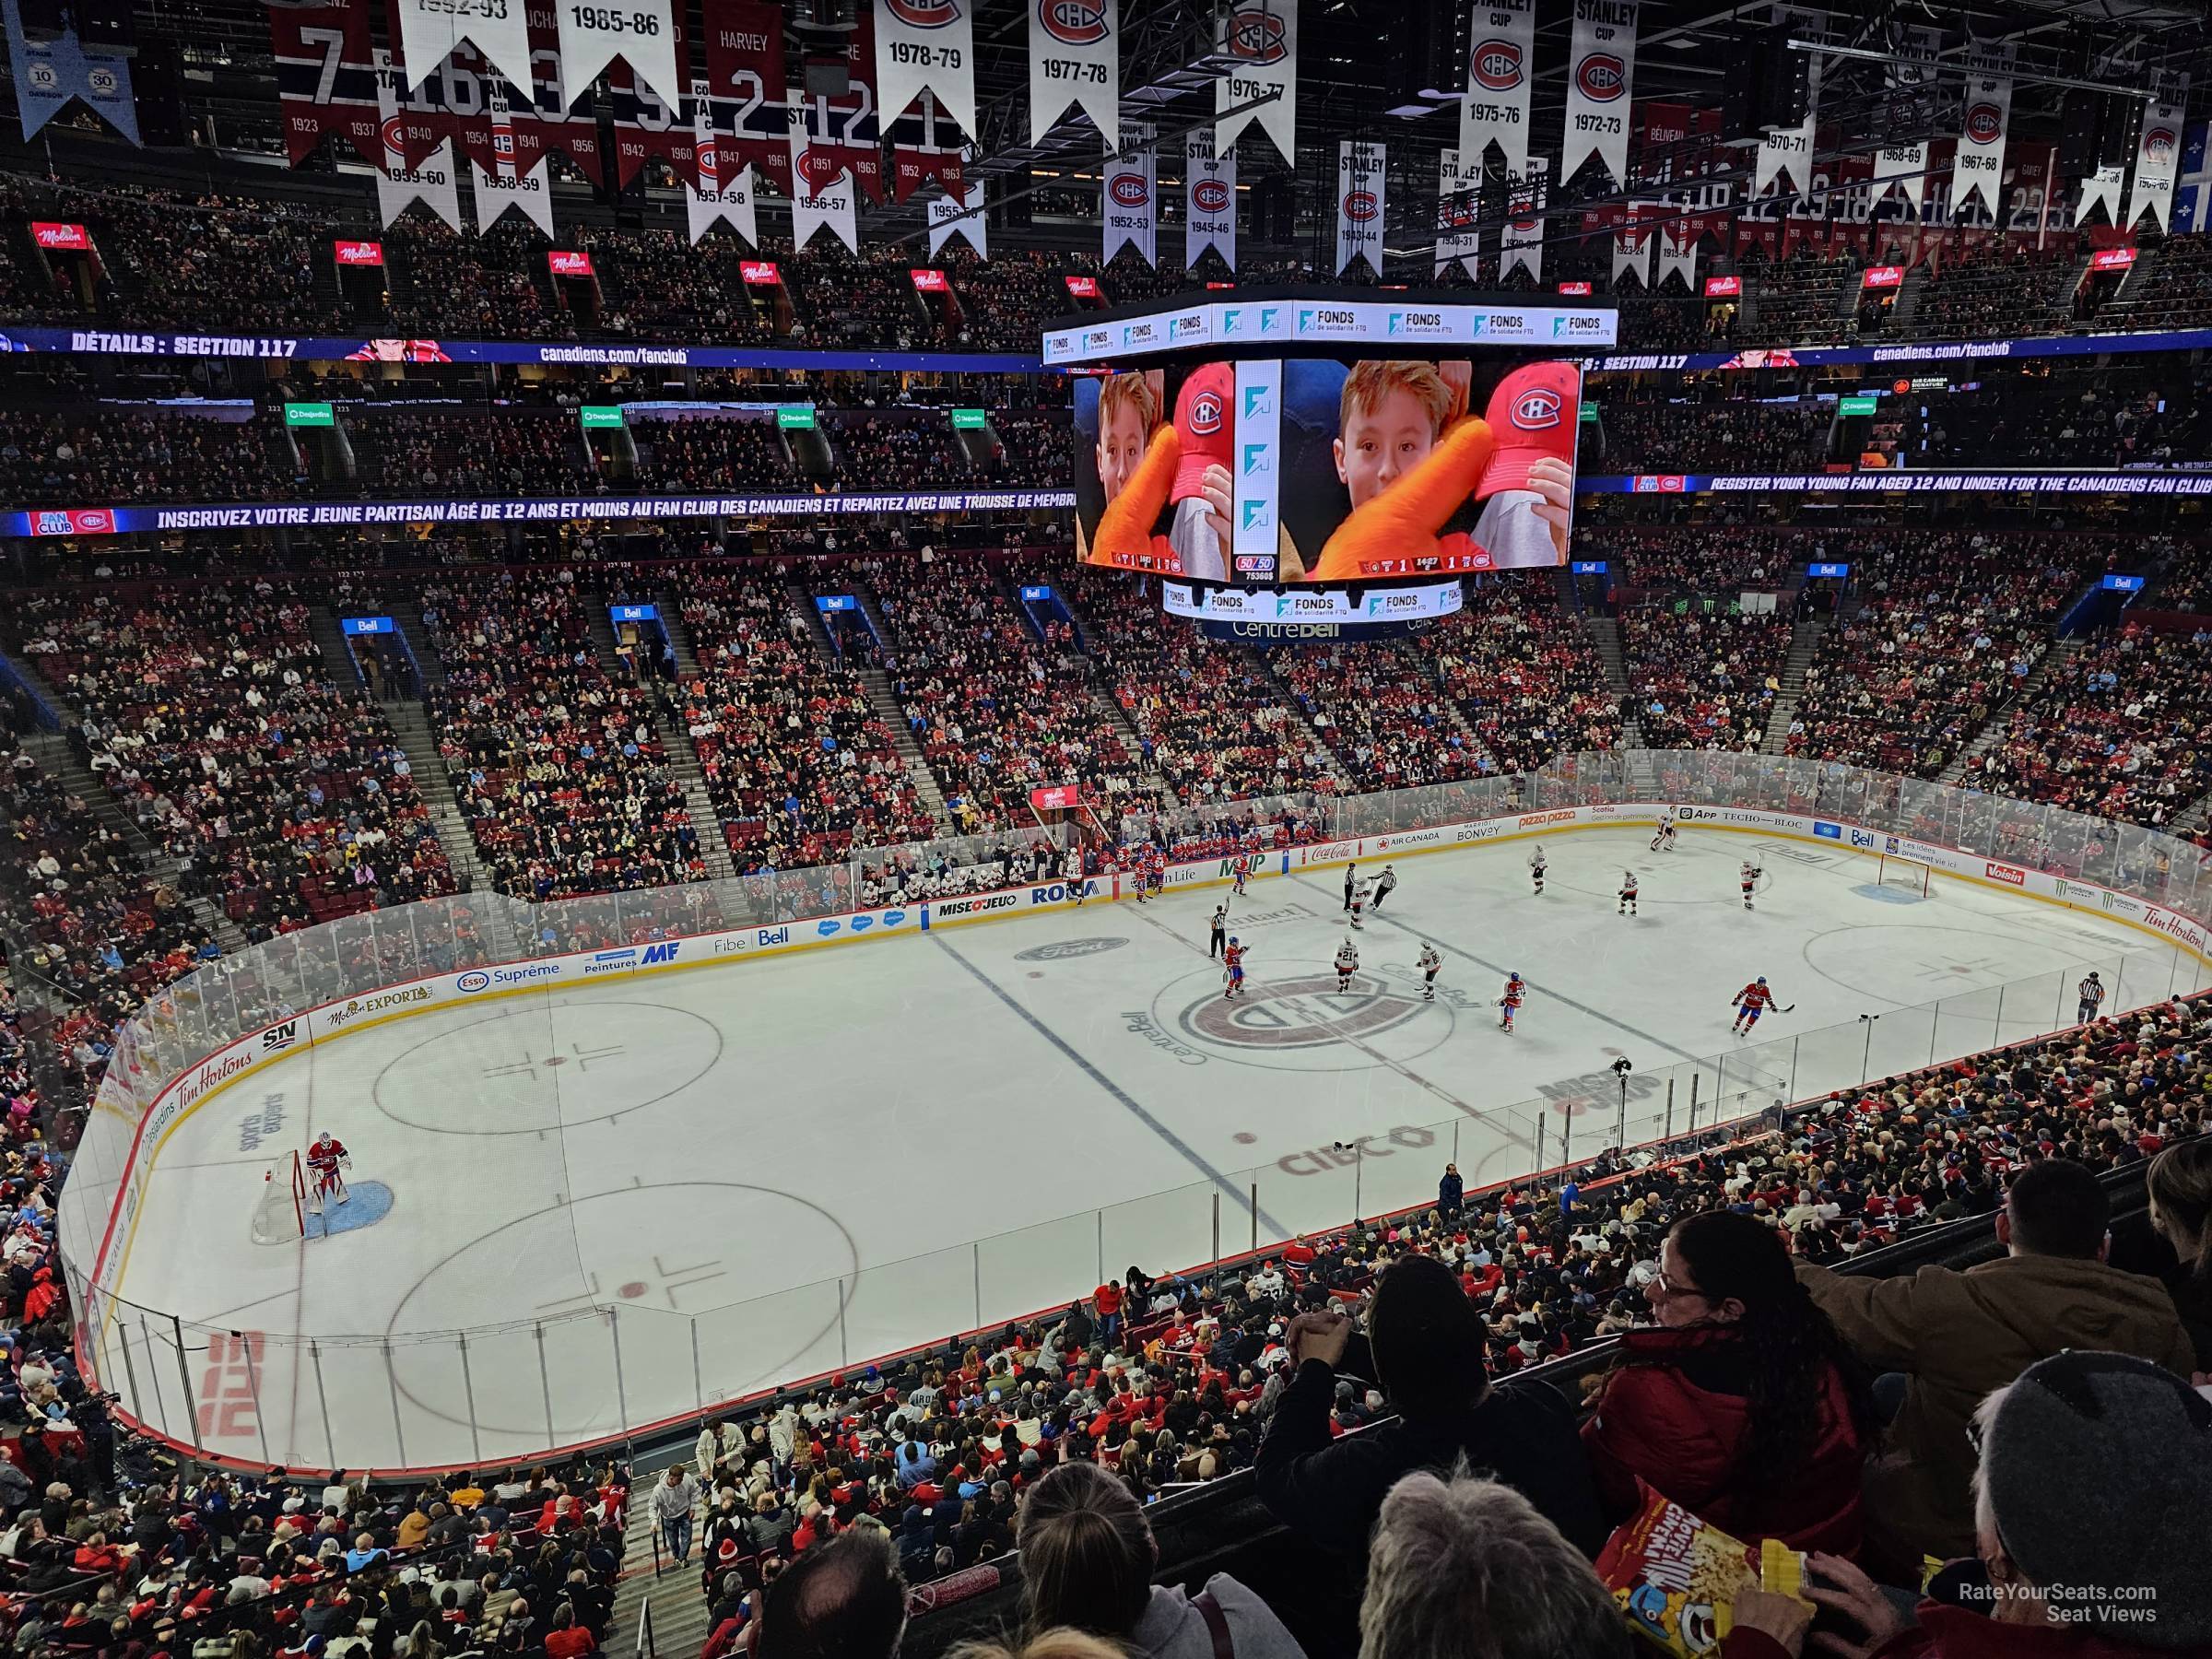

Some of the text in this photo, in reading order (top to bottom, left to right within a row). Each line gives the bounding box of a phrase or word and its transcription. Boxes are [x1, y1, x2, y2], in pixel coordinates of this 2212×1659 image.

[571, 6, 659, 36] 1985-86
[1490, 13, 1512, 27] CUP
[720, 29, 768, 52] HARVEY
[1595, 27, 1615, 41] CUP
[889, 41, 961, 69] 1978-79
[300, 26, 344, 105] 7
[1041, 59, 1107, 84] 1977-78
[34, 71, 52, 82] 10
[93, 75, 112, 87] 30
[1227, 77, 1285, 100] 1976-77
[1982, 81, 1996, 91] CUP
[731, 69, 768, 140] 2
[1470, 103, 1520, 124] 1975-76
[291, 117, 319, 133] 1923
[918, 88, 941, 155] 1
[1575, 114, 1621, 135] 1972-73
[350, 122, 375, 136] 1937
[407, 126, 431, 140] 1940
[1651, 125, 1685, 141] BÉLIVEAU
[465, 131, 488, 145] 1954
[517, 135, 539, 148] 1941
[1767, 135, 1806, 152] 1970-71
[571, 139, 594, 153] 1956
[621, 143, 644, 157] 1942
[671, 147, 692, 160] 1960
[720, 150, 739, 163] 1947
[1883, 147, 1922, 164] 1968-69
[768, 154, 786, 167] 1961
[812, 158, 831, 171] 1951
[1204, 162, 1219, 171] CUP
[1342, 157, 1384, 173] STANLEY
[1961, 155, 1997, 171] 1967-68
[856, 161, 877, 174] 1963
[900, 164, 920, 177] 1952
[942, 168, 960, 180] 1963
[387, 168, 445, 185] 1959-60
[482, 174, 540, 191] 1958-59
[1454, 180, 1468, 190] CUP
[696, 189, 745, 205] 1957-58
[799, 195, 846, 211] 1956-57
[1110, 216, 1148, 229] 1952-53
[1192, 221, 1229, 234] 1945-46
[1692, 220, 1703, 229] 1955
[39, 230, 80, 242] Molson
[1342, 229, 1377, 241] 1943-44
[1442, 236, 1473, 246] 1930-31
[341, 249, 377, 261] Molson
[1617, 244, 1644, 256] 1923-24
[1664, 248, 1690, 258] 1915-16
[549, 257, 584, 270] Molson
[746, 267, 773, 278] Molson
[915, 276, 940, 286] Molson
[1180, 316, 1201, 329] FONDS
[1318, 311, 1355, 324] FONDS
[1406, 313, 1441, 325] FONDS
[1490, 315, 1523, 328] FONDS
[1570, 317, 1600, 329] FONDS
[72, 331, 297, 358] DÉTAILS SECTION 117
[1604, 356, 1688, 371] SECTION 117
[1712, 477, 2212, 493] REGISTER YOUR YOUNG FAN 12 AND UNDER FOR THE CANADIENS FAN CLUB
[158, 509, 250, 528] INSCRIVEZ
[255, 508, 308, 524] VOTRE
[312, 507, 360, 524] JEUNE
[365, 504, 443, 523] PARTISAN
[447, 502, 477, 520] ÂGÉ
[480, 503, 500, 519] DE
[504, 503, 524, 518] 12
[527, 503, 558, 518] ANS
[561, 503, 578, 517] ET
[582, 502, 629, 517] MOINS
[632, 501, 651, 516] AU
[653, 501, 679, 516] FAN
[682, 500, 717, 515] CLUB
[721, 500, 745, 514] DES
[748, 499, 821, 513] CANADIENS
[824, 499, 841, 512] ET
[842, 497, 902, 512] REPARTEZ
[906, 496, 935, 511] AVEC
[938, 495, 961, 510] UNE
[965, 494, 1015, 509] TROUSSE
[1017, 494, 1033, 508] DE
[41, 512, 66, 524] FAN
[40, 523, 73, 535] CLUB
[1240, 557, 1273, 569] 50/50
[1400, 559, 1406, 571] 1
[1449, 557, 1455, 569] 1
[1583, 564, 1595, 572] Bell
[1821, 565, 1836, 575] Bell
[2115, 578, 2131, 588] Bell
[1026, 589, 1040, 597] Bell
[828, 598, 842, 608] Bell
[1212, 595, 1242, 607] FONDS
[1277, 599, 1315, 609] FONDS
[1387, 595, 1418, 606] FONDS
[625, 608, 641, 618] Bell
[358, 620, 377, 631] Bell
[1464, 819, 1496, 829] MARRIOTT
[1519, 810, 1576, 830] pizza pizza
[1390, 832, 1440, 846] AIR CANADA
[1852, 830, 1874, 847] Bell
[1175, 869, 1195, 882] Life
[1988, 864, 2023, 883] Voisin
[2145, 906, 2167, 930] Tim
[715, 927, 789, 953] Fibe Bell
[641, 942, 680, 965] MF
[1342, 951, 1353, 961] 21
[585, 959, 637, 974] Peintures
[494, 964, 559, 983] Suprême
[327, 987, 419, 1026] Molson EXPORT
[263, 1021, 296, 1048] SN
[176, 1052, 252, 1110] Tim Hortons
[146, 1101, 175, 1151] Desjardins
